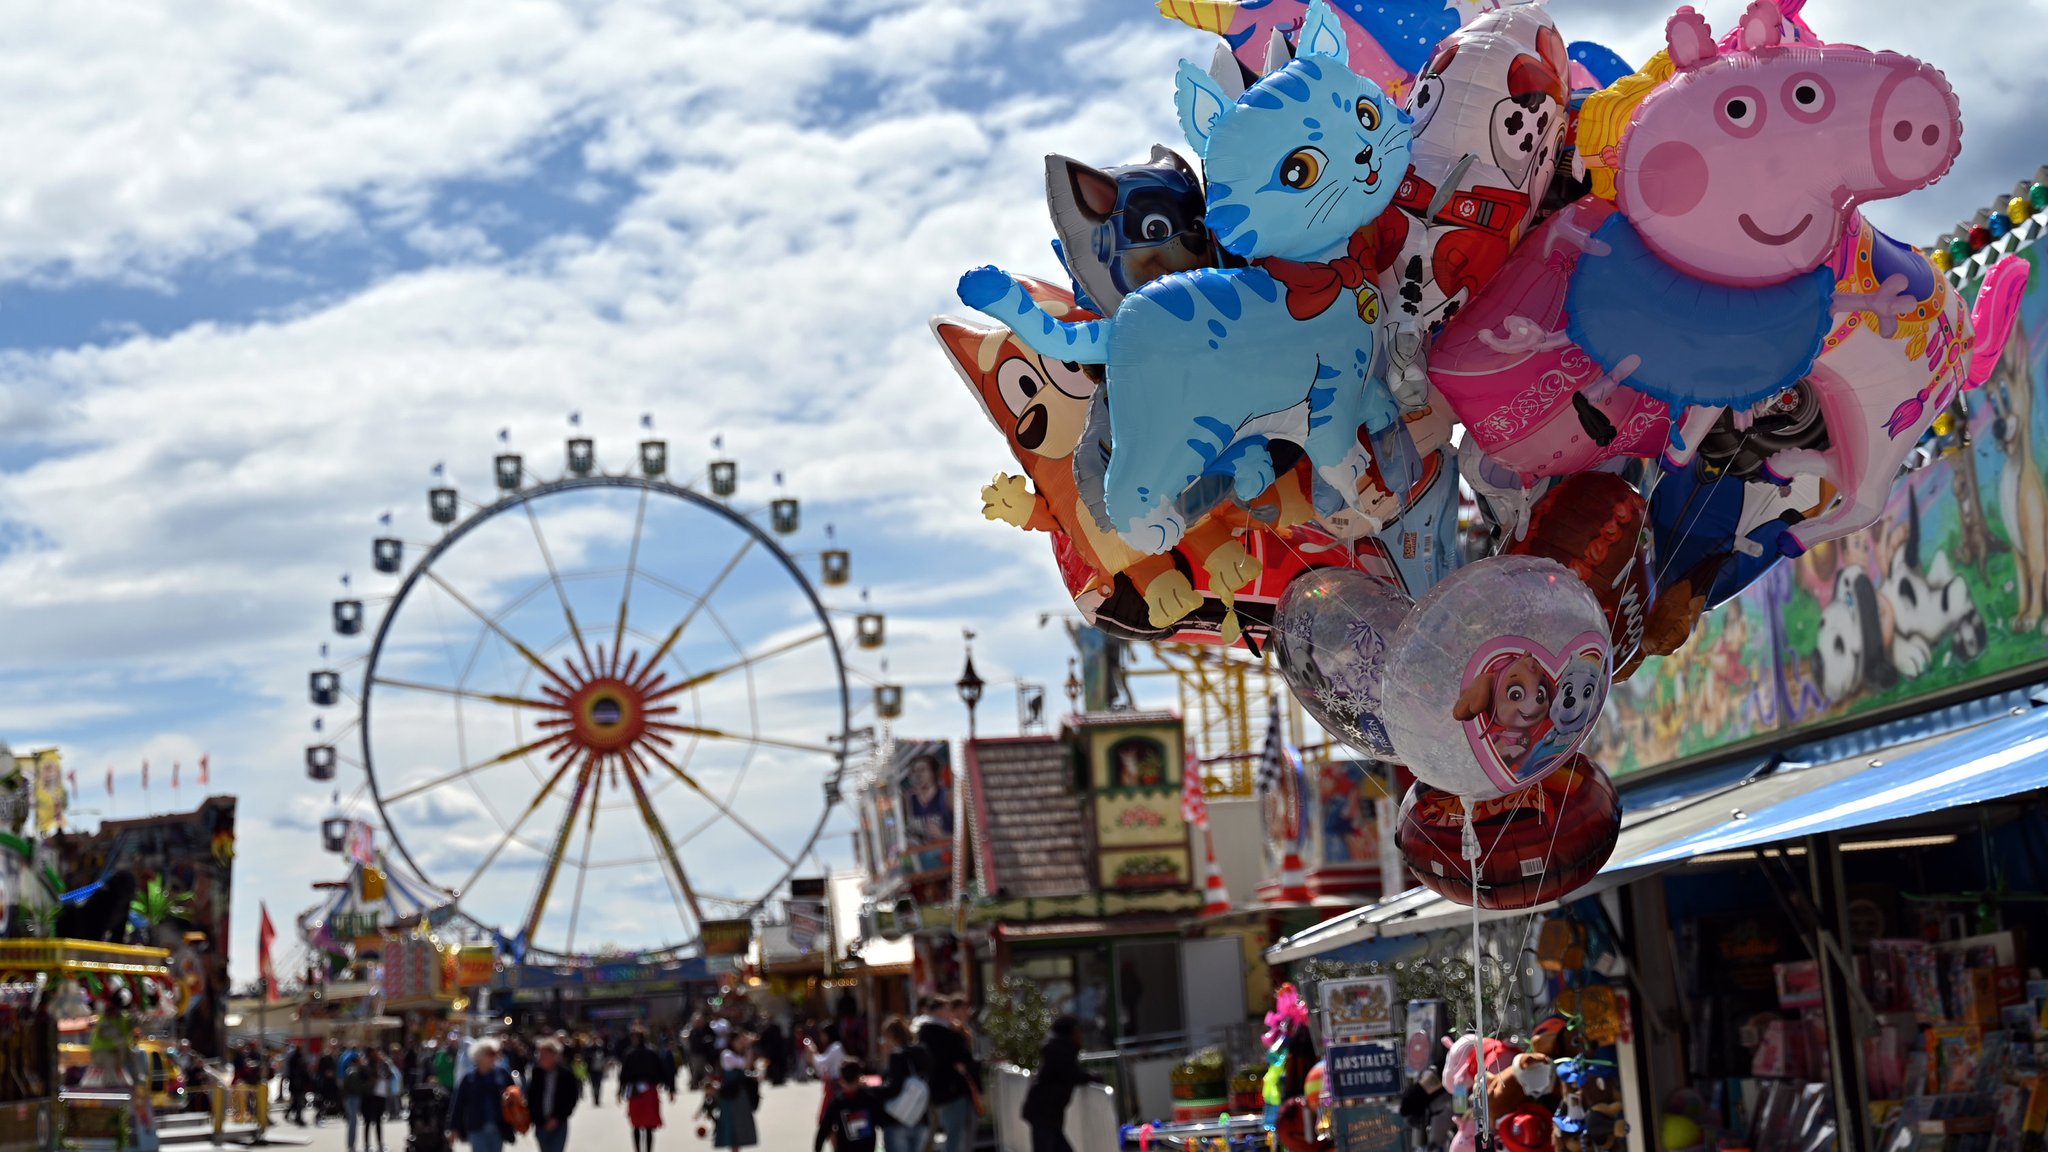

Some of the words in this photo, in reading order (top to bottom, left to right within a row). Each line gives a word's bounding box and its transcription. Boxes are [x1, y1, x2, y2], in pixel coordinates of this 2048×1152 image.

[1366, 719, 1394, 748] FROZEN
[1334, 1053, 1396, 1070] ANSTALTS
[1340, 1071, 1393, 1087] LEITUNG
